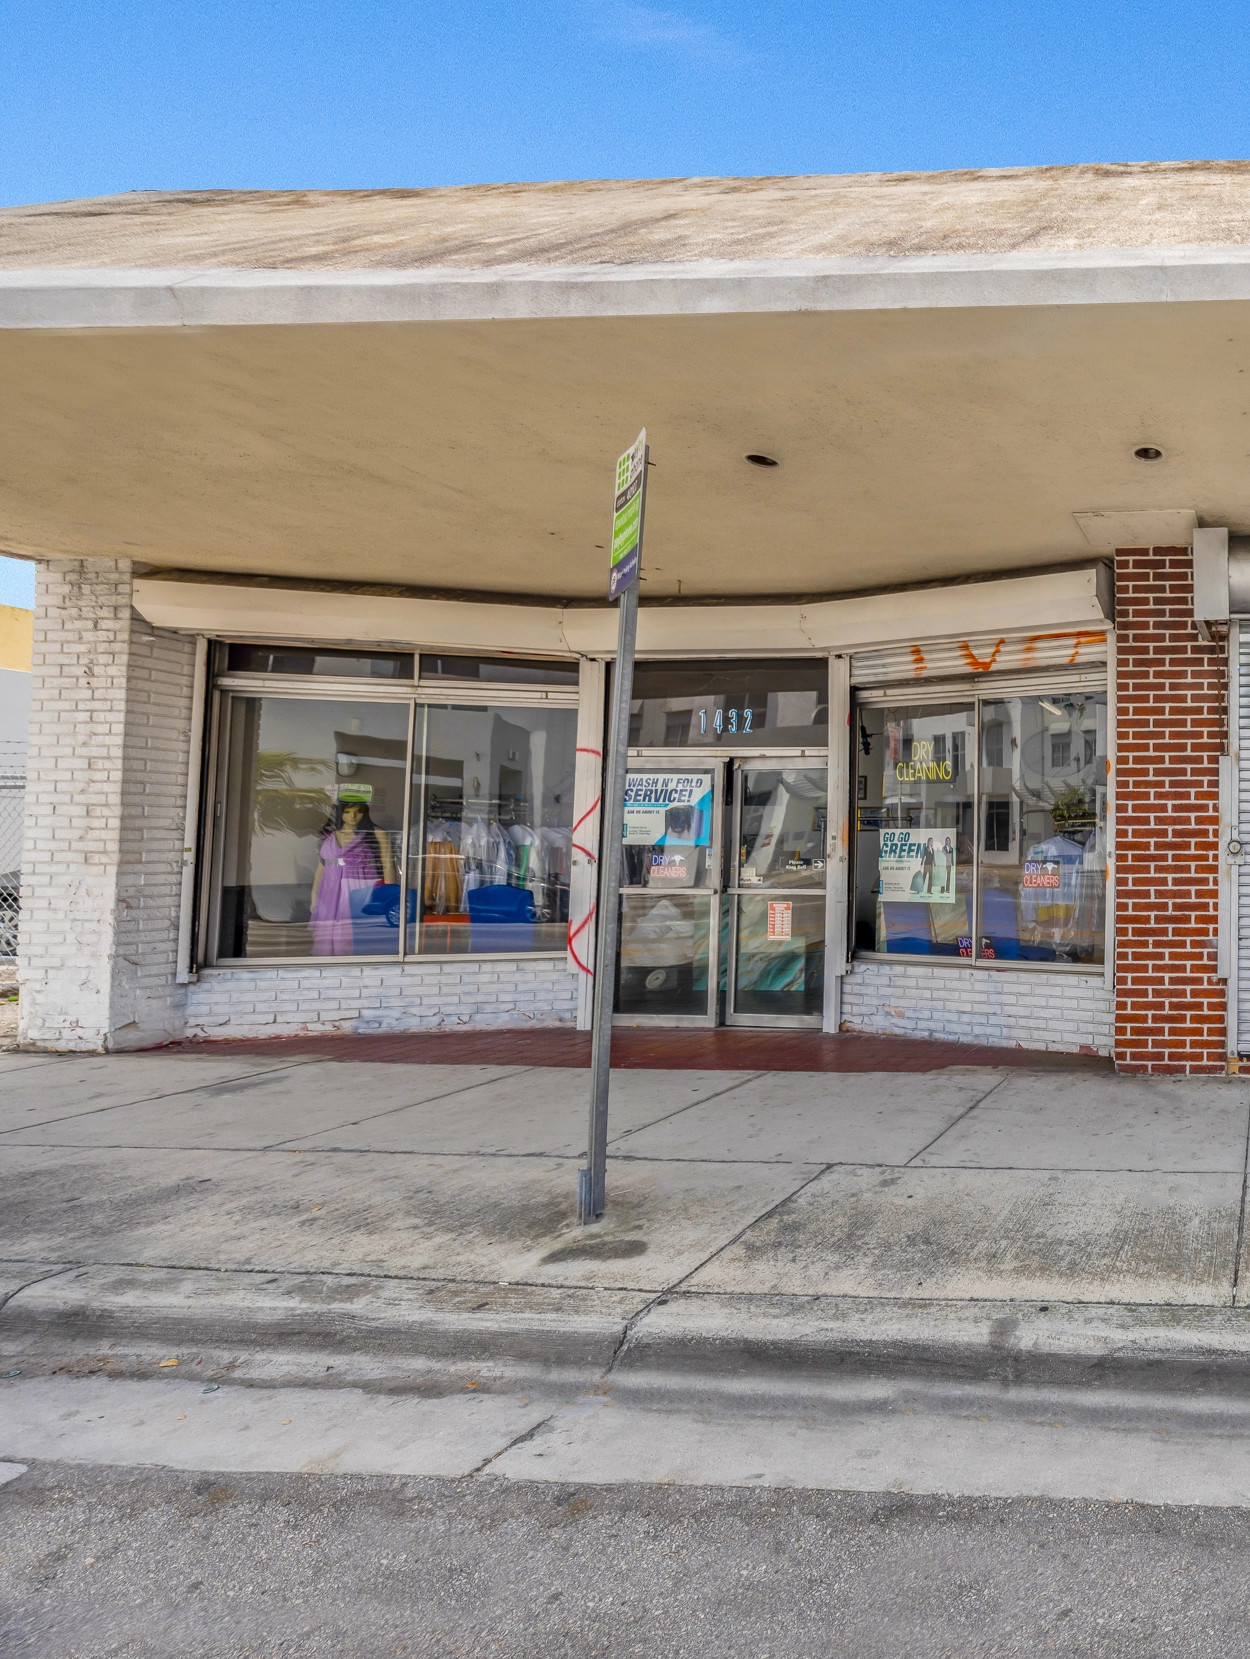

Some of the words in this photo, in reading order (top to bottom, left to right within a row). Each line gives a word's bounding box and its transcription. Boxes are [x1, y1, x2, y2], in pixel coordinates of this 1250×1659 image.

[699, 709, 753, 733] 1432
[911, 741, 935, 760] DRY
[896, 761, 953, 781] CLEANING
[627, 777, 659, 788] WASH
[661, 777, 674, 788] N'
[675, 777, 704, 788] FOLD
[624, 788, 694, 803] SERVICE!
[883, 832, 896, 843] GO
[897, 832, 911, 843] GO
[880, 843, 927, 859] GREEN
[652, 854, 671, 866] DRY
[650, 866, 687, 877] CLEANERS
[1024, 862, 1043, 874] DRY
[1023, 874, 1060, 887] CLEANERS
[959, 948, 996, 959] CLEERS
